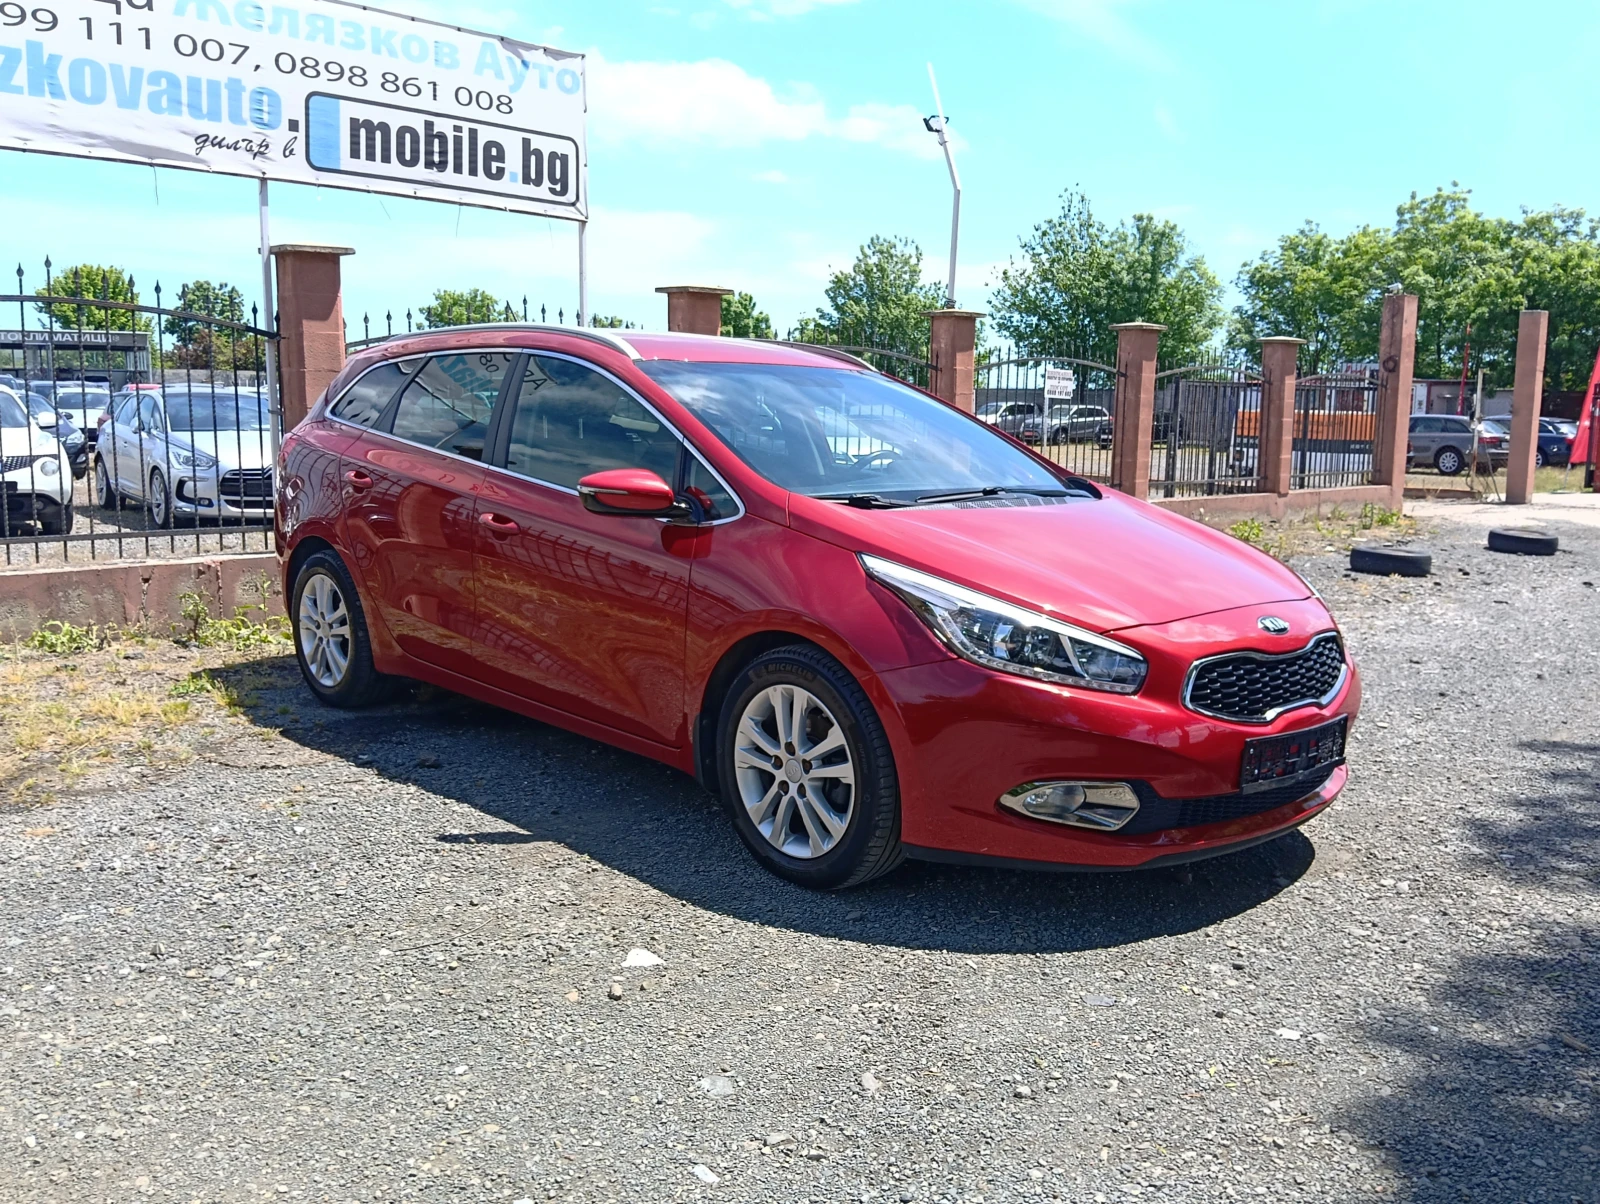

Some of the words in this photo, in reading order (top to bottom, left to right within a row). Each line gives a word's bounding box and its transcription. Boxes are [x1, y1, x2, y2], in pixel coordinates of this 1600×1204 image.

[79, 17, 151, 50] 111
[173, 33, 260, 72] 007,
[274, 52, 368, 87] 0898
[380, 71, 437, 101] 861
[454, 86, 514, 114] 008
[474, 41, 581, 94] Ауто
[350, 117, 569, 197] mobile.bg
